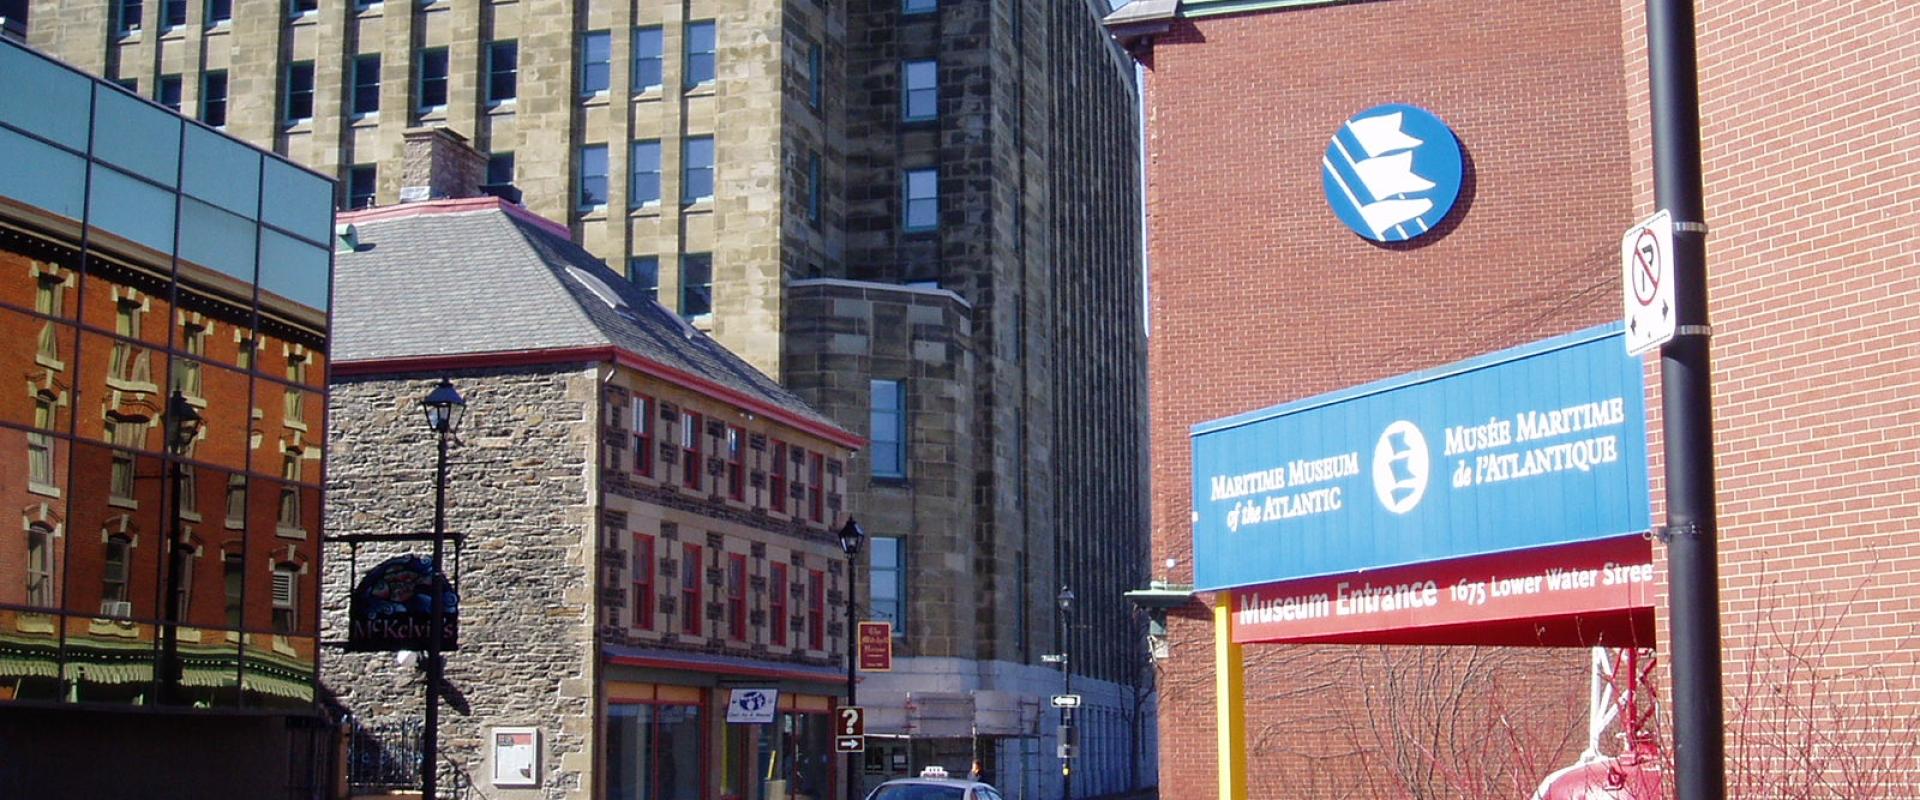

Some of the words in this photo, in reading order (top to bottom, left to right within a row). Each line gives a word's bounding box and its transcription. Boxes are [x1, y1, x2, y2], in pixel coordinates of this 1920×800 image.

[1288, 451, 1359, 487] MUSEUM
[1453, 460, 1472, 488] de
[1227, 501, 1242, 532] of
[1242, 499, 1261, 525] the
[1263, 486, 1342, 521] ATLANTIC
[1240, 592, 1330, 625] Museum
[1336, 579, 1438, 616] Entrance
[1450, 578, 1486, 605] 1675
[1491, 576, 1543, 598] Lower
[1546, 567, 1598, 591] Water
[1603, 562, 1654, 586] Stree
[353, 616, 454, 640] McKelvi's
